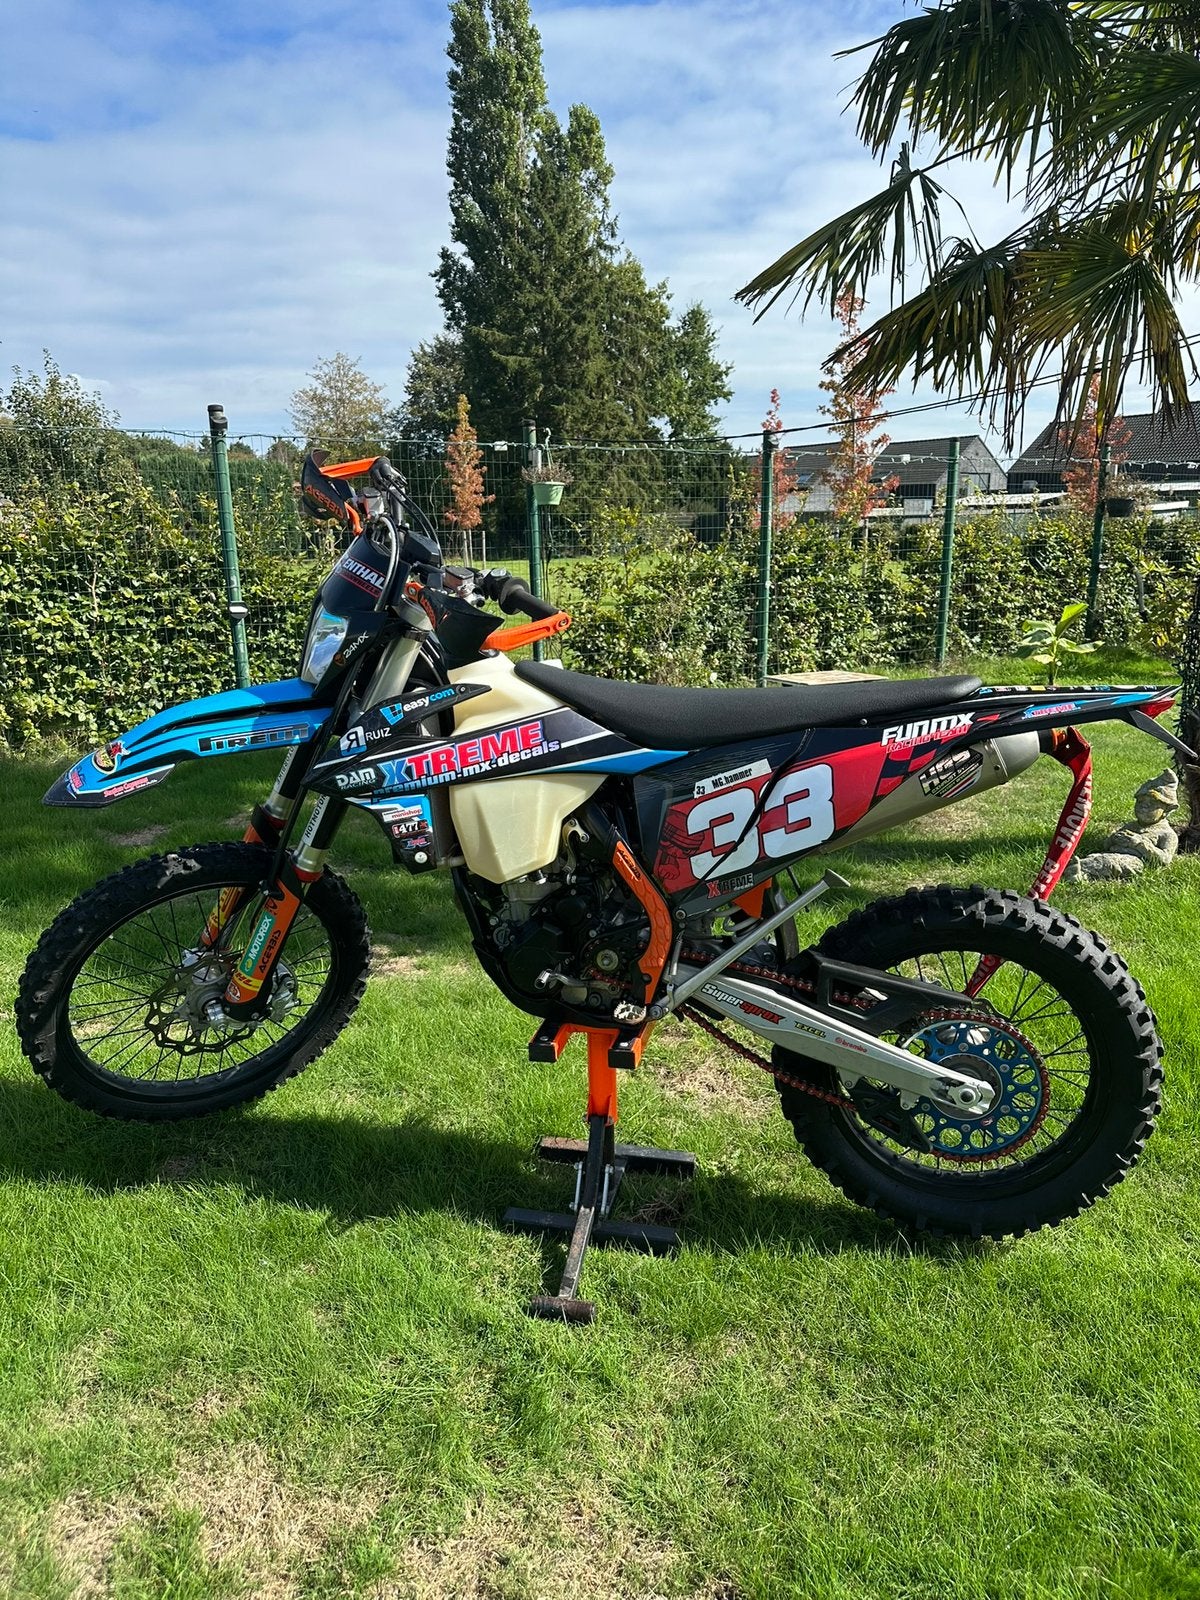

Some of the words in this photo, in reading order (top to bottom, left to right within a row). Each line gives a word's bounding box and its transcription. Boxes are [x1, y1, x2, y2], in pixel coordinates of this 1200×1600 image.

[343, 631, 369, 658] 24MX
[403, 688, 455, 712] easycom
[365, 727, 392, 741] RUIZ
[377, 721, 544, 788] XTREME
[335, 767, 376, 787] DAM
[697, 786, 706, 795] 33
[687, 763, 836, 881] 33
[248, 915, 272, 960] MOTOREX
[795, 1020, 826, 1038] EXCEL
